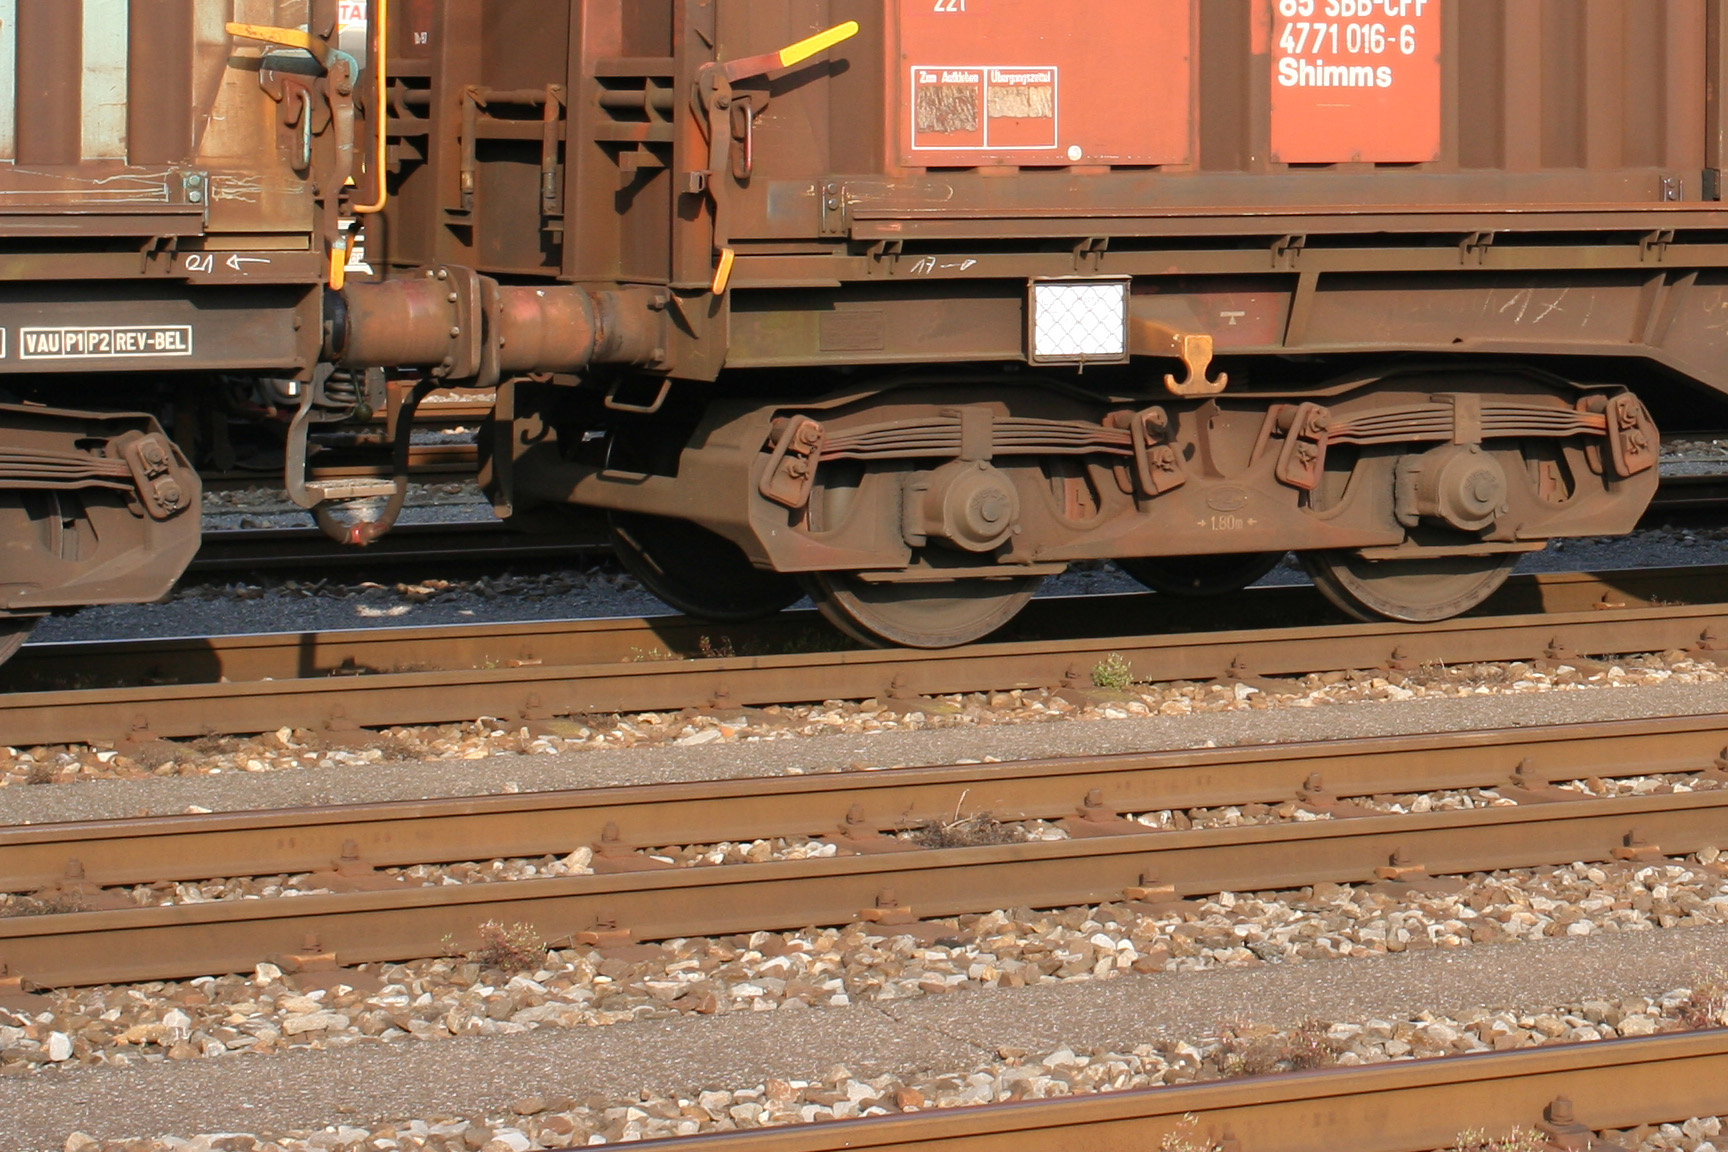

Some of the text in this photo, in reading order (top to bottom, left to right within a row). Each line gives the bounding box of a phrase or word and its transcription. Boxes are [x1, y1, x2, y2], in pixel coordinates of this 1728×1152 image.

[1279, 22, 1416, 56] 4771 016-6
[1277, 57, 1393, 88] Shimms
[26, 331, 186, 353] VAU P1 P2 REV-BEL
